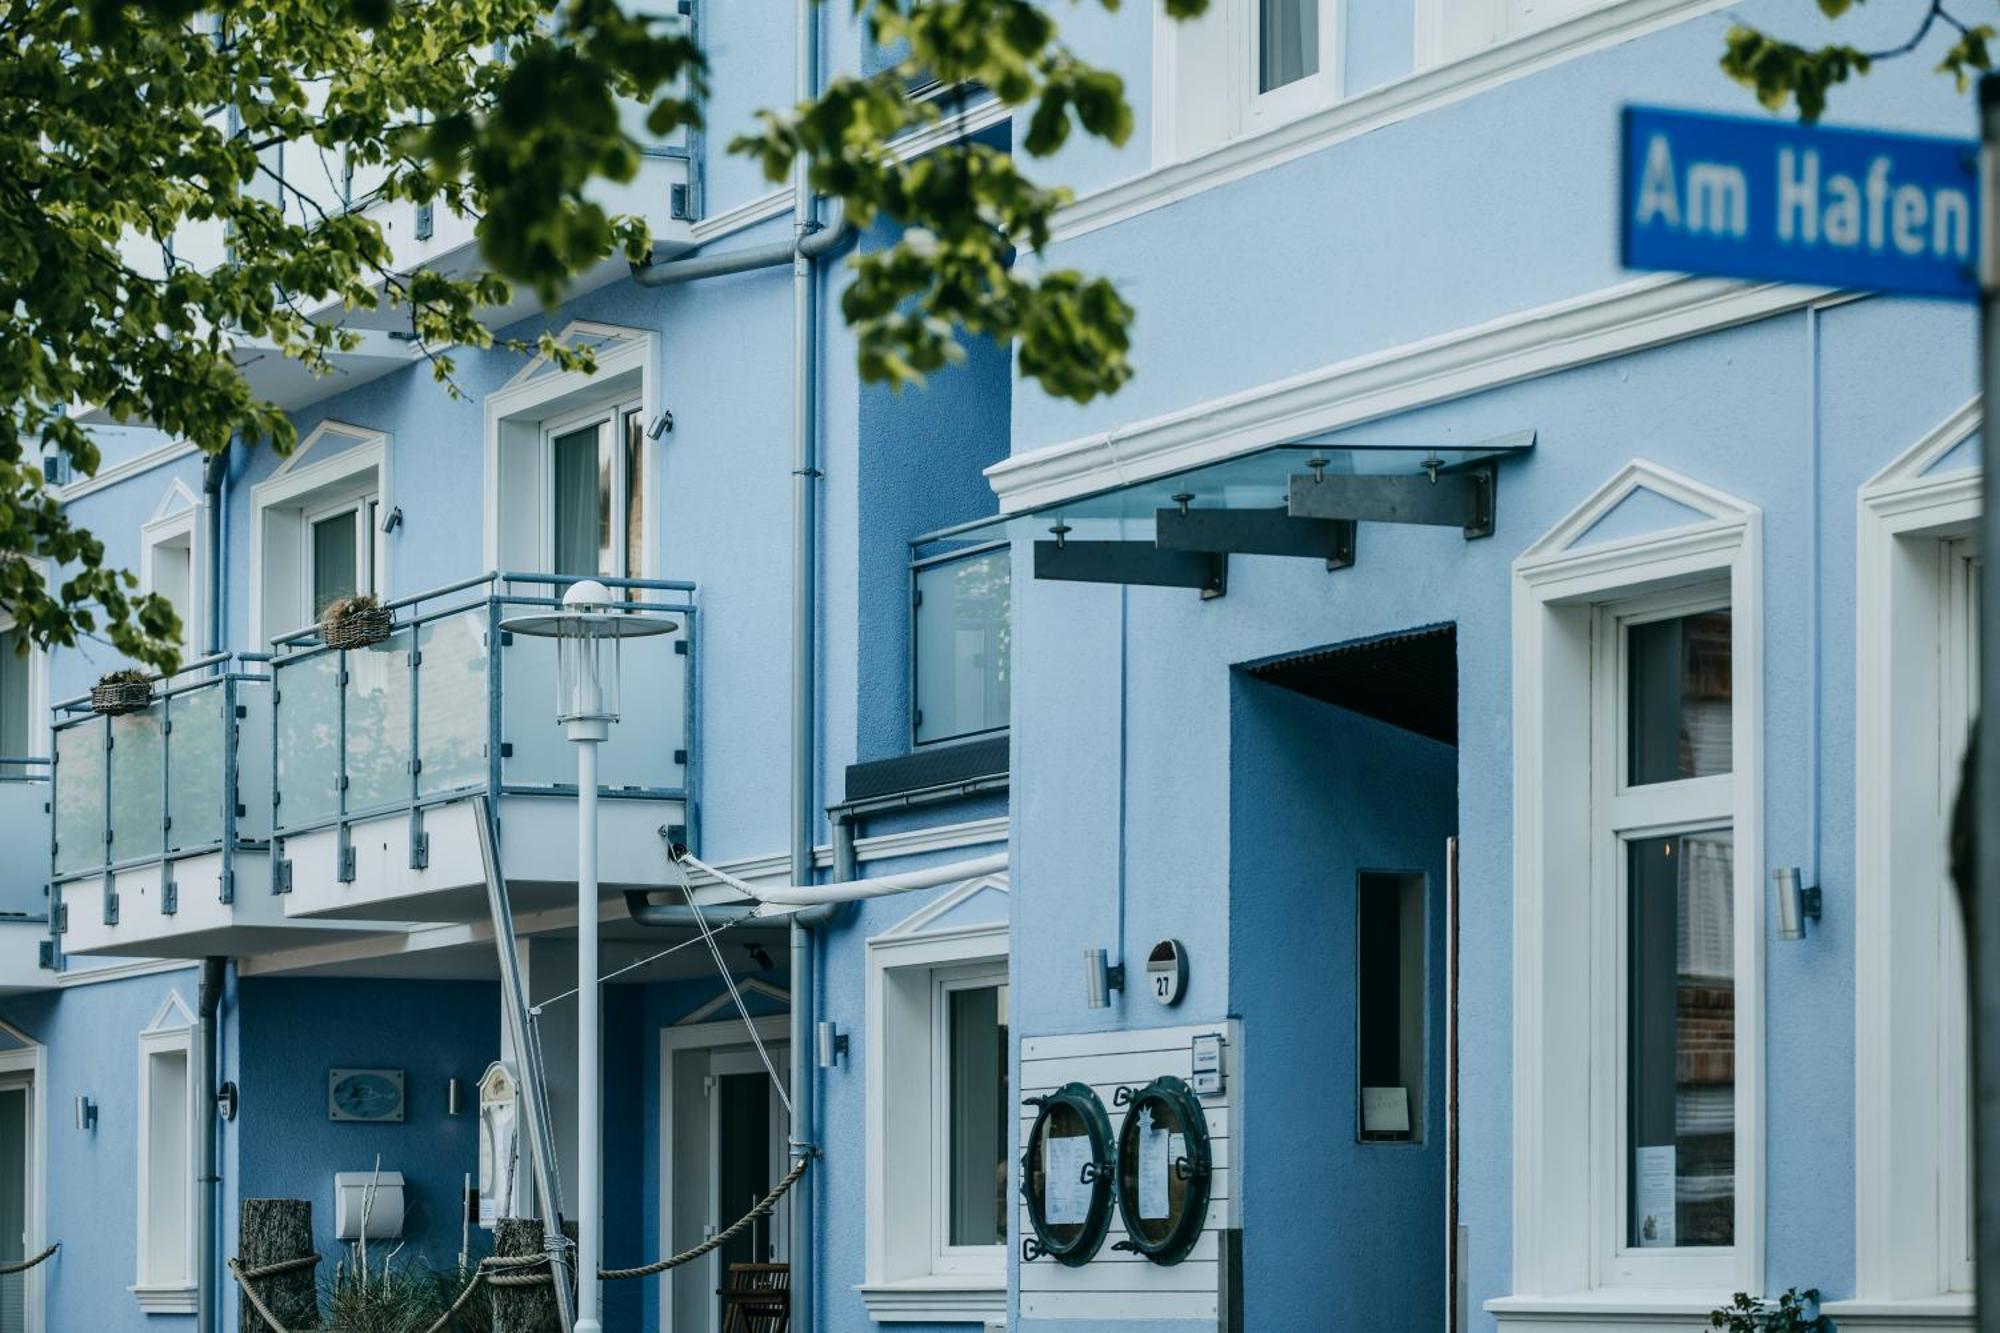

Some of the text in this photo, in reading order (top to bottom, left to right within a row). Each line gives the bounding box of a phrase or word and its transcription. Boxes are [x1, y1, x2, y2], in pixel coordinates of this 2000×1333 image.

[1636, 134, 1970, 258] Am Hafen
[1156, 976, 1169, 996] 27
